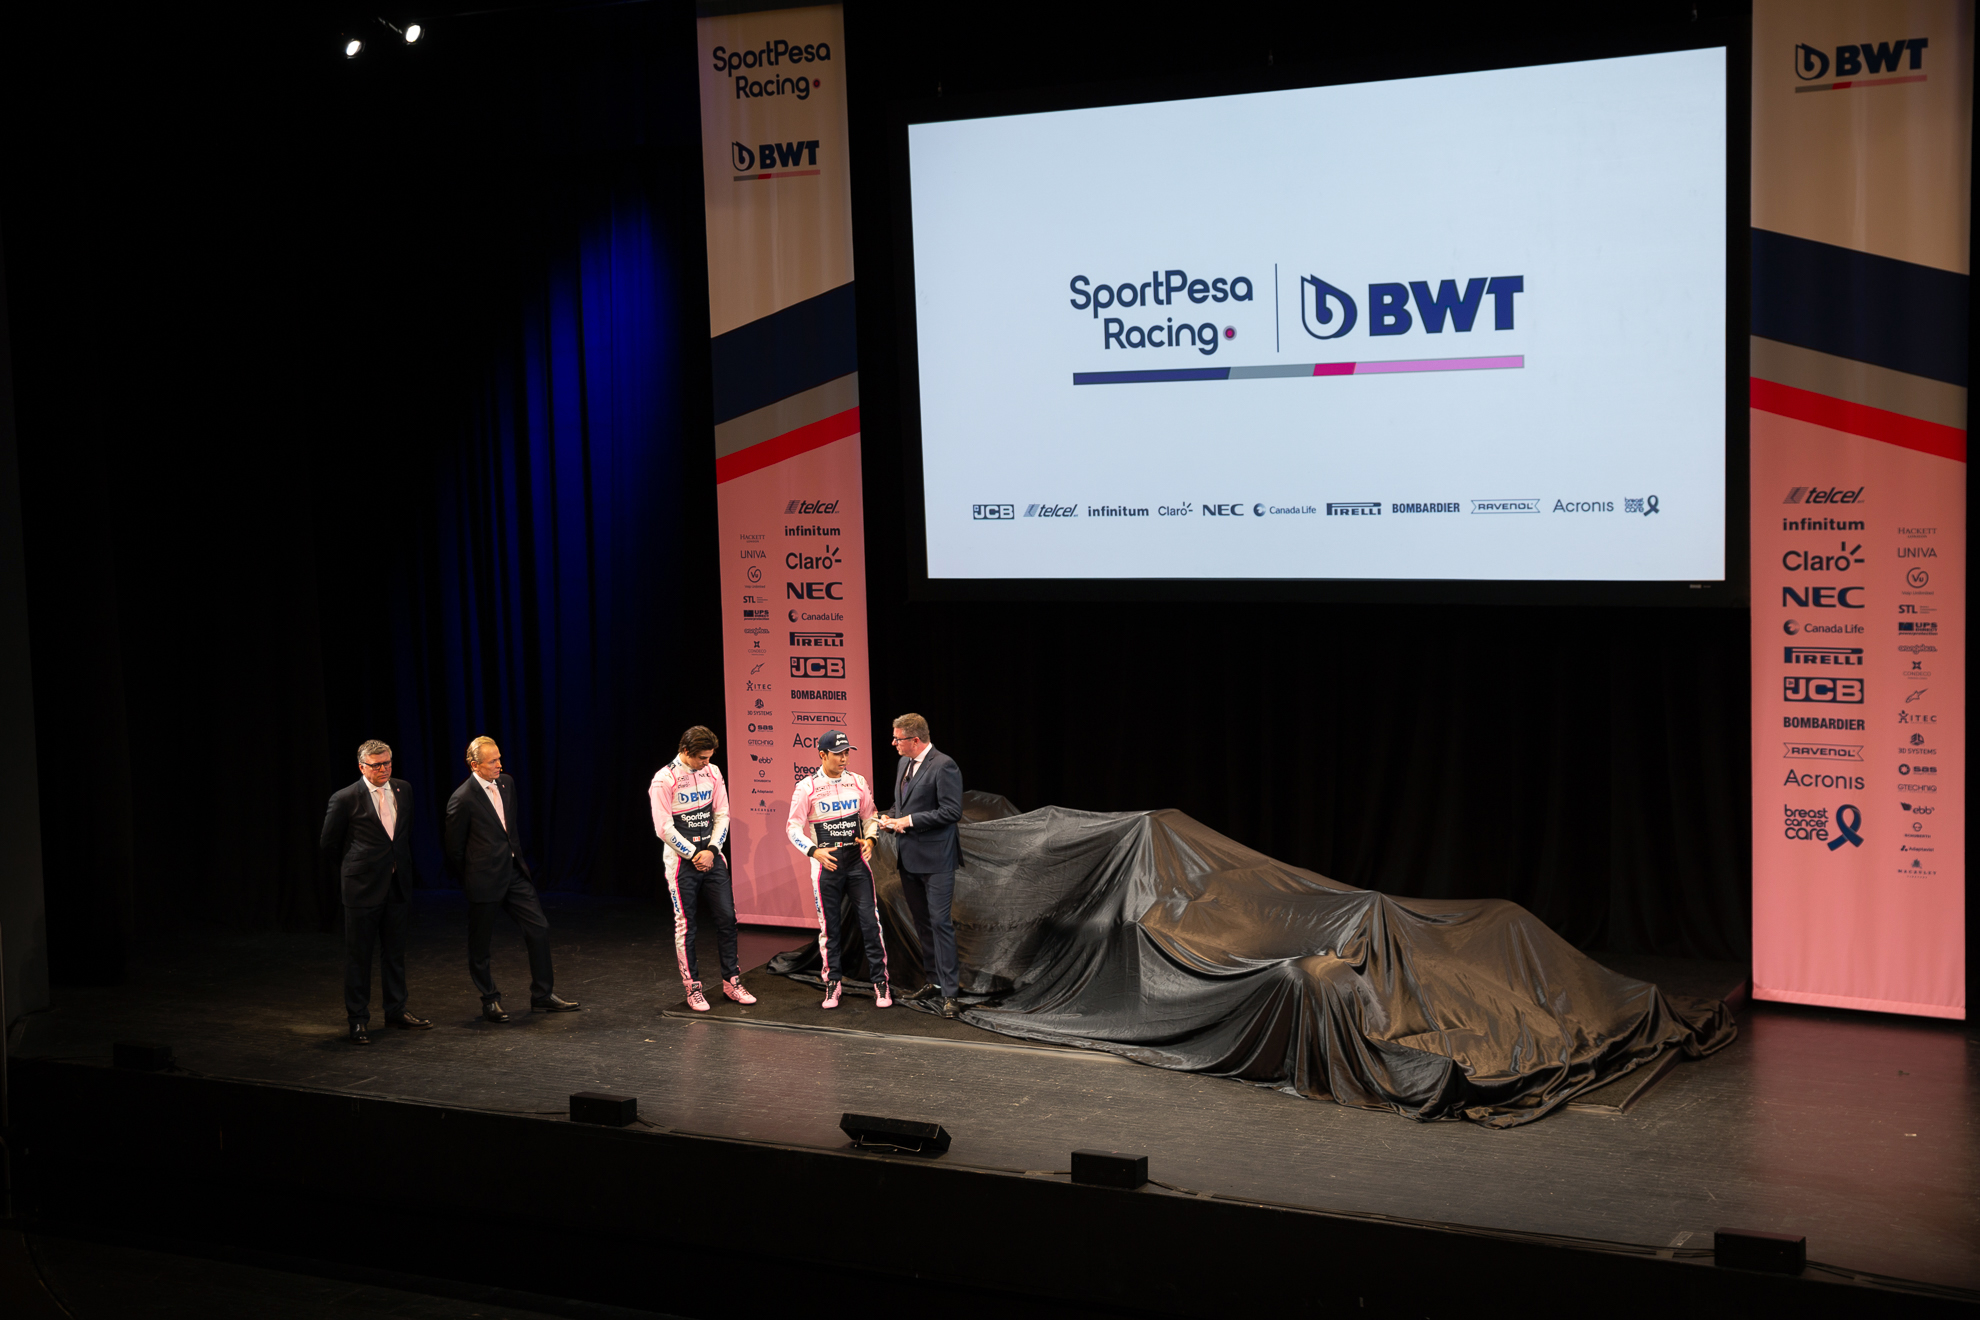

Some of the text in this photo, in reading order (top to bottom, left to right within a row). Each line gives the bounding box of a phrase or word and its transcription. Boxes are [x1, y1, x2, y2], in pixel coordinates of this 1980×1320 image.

[712, 39, 831, 77] SportPesa
[1836, 37, 1929, 77] BWT
[735, 73, 810, 100] Racing
[758, 139, 820, 170] BWT
[1069, 269, 1254, 319] SportPesa
[1368, 274, 1525, 337] BWT
[1103, 317, 1219, 356] Racing
[1805, 486, 1865, 504] telcel
[798, 499, 840, 514] telcel
[973, 504, 1015, 520] JCB
[1038, 503, 1078, 518] telcel
[1087, 506, 1150, 517] infinitum
[1158, 505, 1188, 516] Claro
[1202, 503, 1245, 517] NEC
[1269, 505, 1317, 515] Canada Life
[1326, 502, 1382, 516] PIRELLI
[1392, 502, 1461, 514] BOMBARDIER
[1477, 502, 1531, 511] RAVENOL
[1552, 499, 1615, 513] Acronis
[784, 525, 841, 537] infinitum
[1783, 517, 1865, 531] infinitum
[1898, 527, 1938, 535] HACKETT
[740, 550, 767, 559] UNIVA
[1897, 547, 1938, 559] UNIVA
[785, 552, 834, 570] Claro
[1782, 550, 1851, 572] Claro
[786, 581, 844, 601] NEC
[1782, 586, 1865, 609] NEC
[743, 595, 756, 604] STL
[1898, 604, 1918, 614] STL
[801, 612, 844, 621] Canada Life
[1804, 623, 1865, 634] Canada Life
[789, 631, 845, 647] PIRELLI
[1784, 646, 1864, 666] PIRELLI
[791, 658, 845, 677] JCB
[790, 689, 848, 701] BOMBARDIER
[1785, 678, 1863, 702] JCB
[796, 714, 842, 723] RAVENOL
[1783, 716, 1865, 731] BOMBARDIER
[1910, 714, 1937, 722] ITEC
[792, 732, 819, 749] Acr
[1791, 746, 1856, 758] RAVENOL
[793, 761, 822, 774] breas
[1783, 768, 1865, 790] Acronis
[690, 789, 713, 803] BWT
[831, 798, 858, 812] BWT
[1784, 803, 1829, 819] breast
[681, 811, 711, 822] SportPesa
[1784, 818, 1829, 828] cancer
[822, 820, 857, 831] SportPesa
[829, 828, 853, 837] Racing
[1784, 827, 1829, 841] care
[675, 841, 692, 857] BWT
